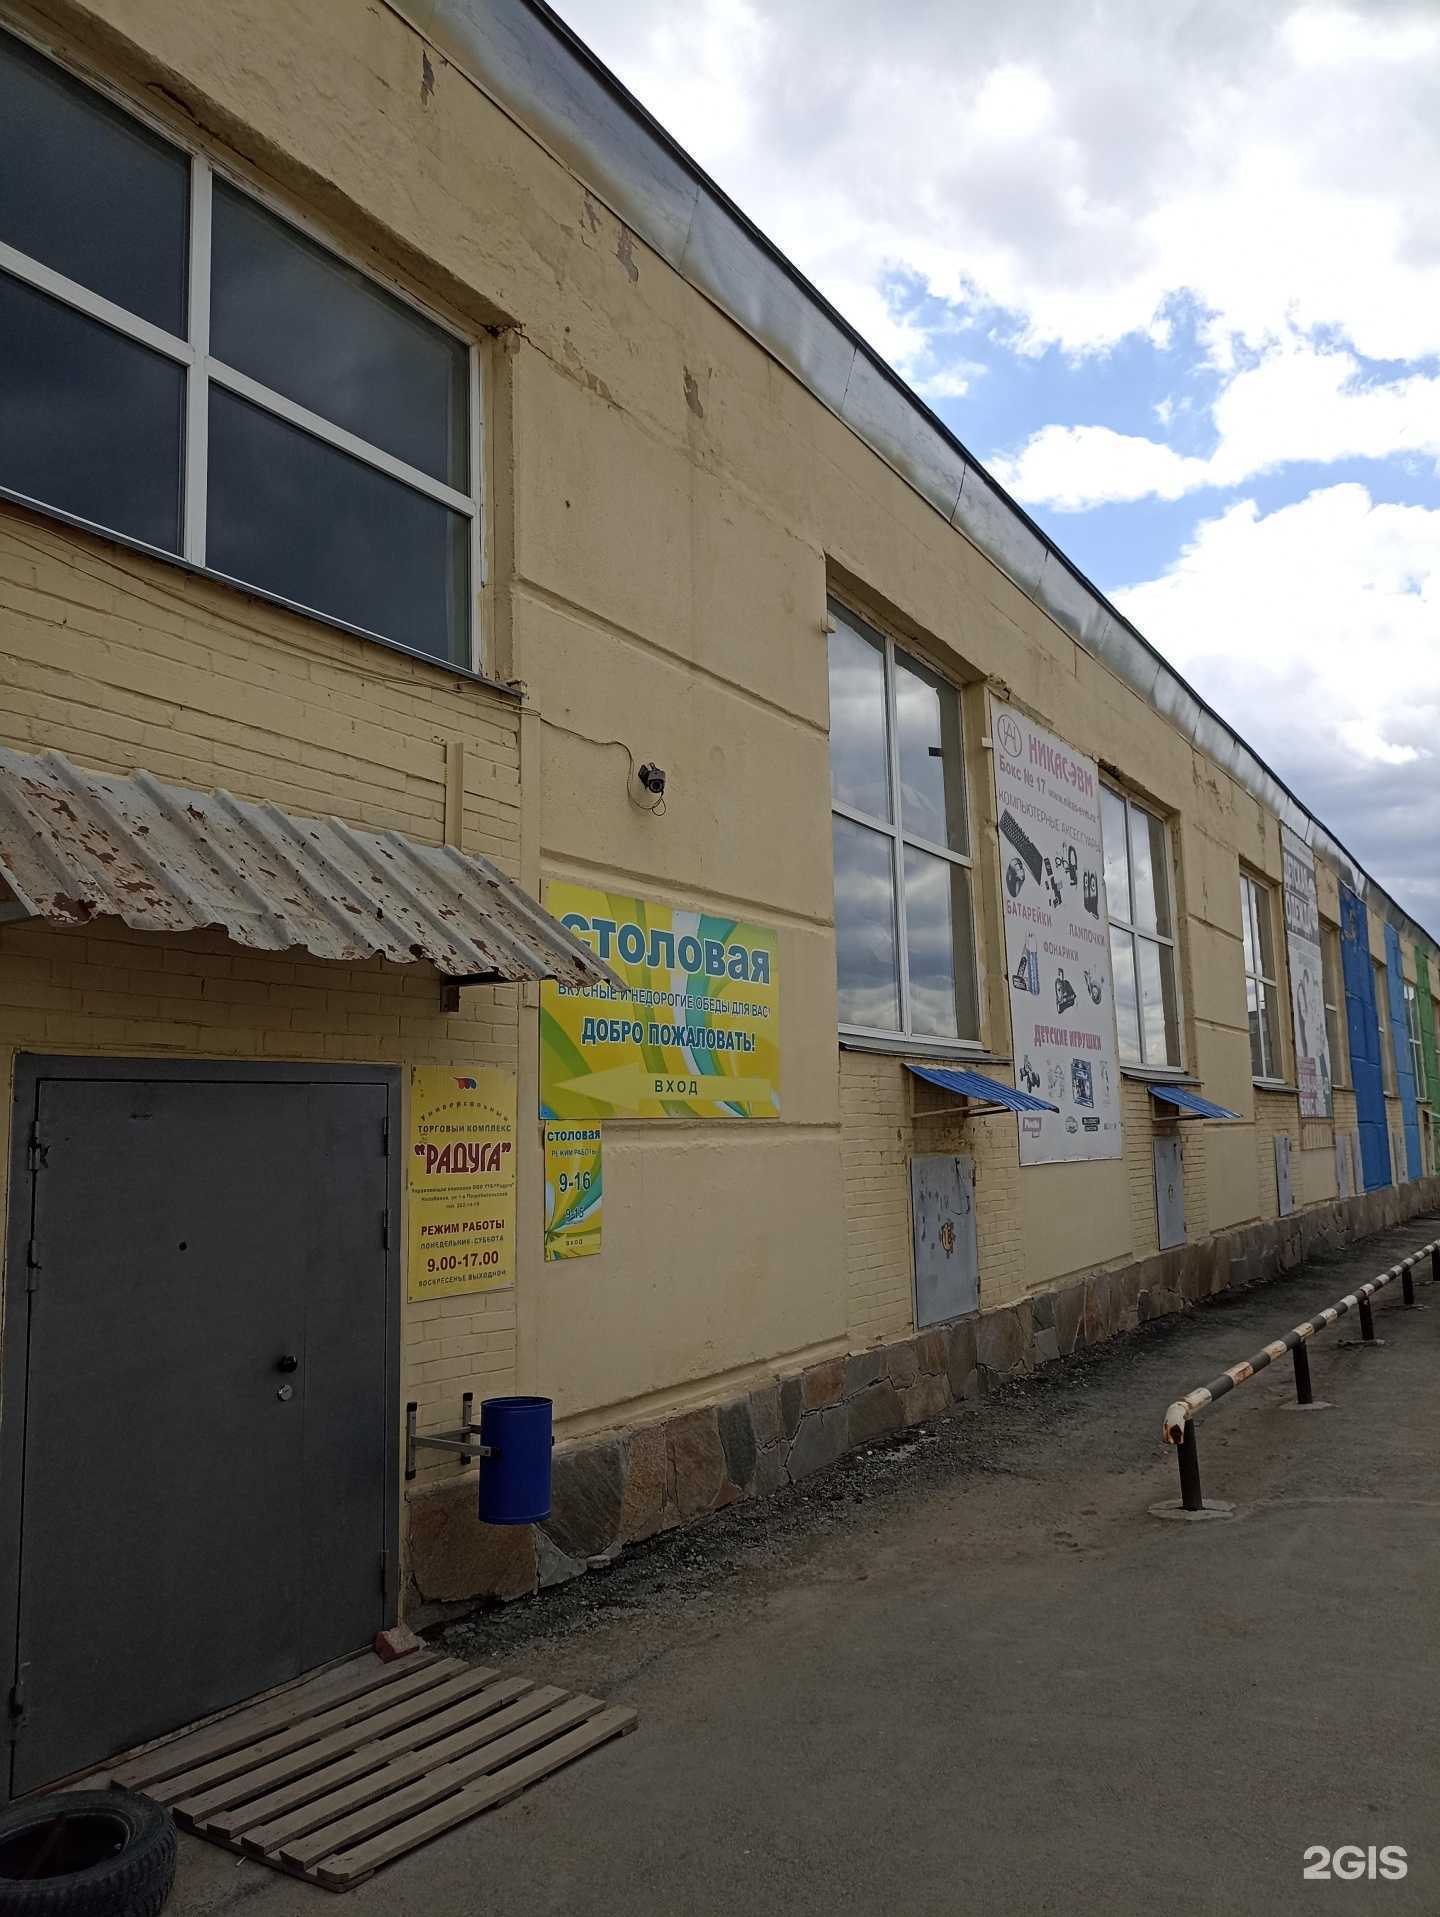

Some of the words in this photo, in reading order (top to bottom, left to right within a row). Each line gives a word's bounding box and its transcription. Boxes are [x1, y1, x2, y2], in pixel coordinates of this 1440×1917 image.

[1000, 754, 1022, 780] Бокс
[1036, 775, 1046, 795] 17
[1028, 734, 1094, 798] НИКАС-ЭВМ
[999, 787, 1060, 833] КОМПЬЮТЕРНЫЕ
[1006, 900, 1052, 927] БАТАРЕЙКИ
[1069, 923, 1106, 947] ЛАМПОЧКИ
[1043, 941, 1079, 962] ФОНАРИКИ
[631, 989, 693, 1009] НЕДОРОГИЕ
[696, 996, 730, 1014] ОБЕДЫ
[732, 1001, 750, 1016] ДЛЯ
[582, 1017, 643, 1045] ДОБРО
[648, 1023, 756, 1052] ПОЖАЛОВАТЬ!
[1034, 1024, 1068, 1047] ДЕТСКИЕ
[1069, 1030, 1102, 1051] ИГРУШКИ
[654, 1079, 698, 1095] ВХОД
[418, 1124, 464, 1133] ТОРГОВЫЙ
[466, 1124, 511, 1133] КОМПЛЕКС
[559, 1171, 592, 1193] 9-16
[421, 1223, 459, 1236] РЕЖИМ
[462, 1218, 505, 1233] РАБОТЫ
[427, 1250, 499, 1273] 9.00-17.00
[468, 1269, 506, 1281] ВЫХОДНОЙ
